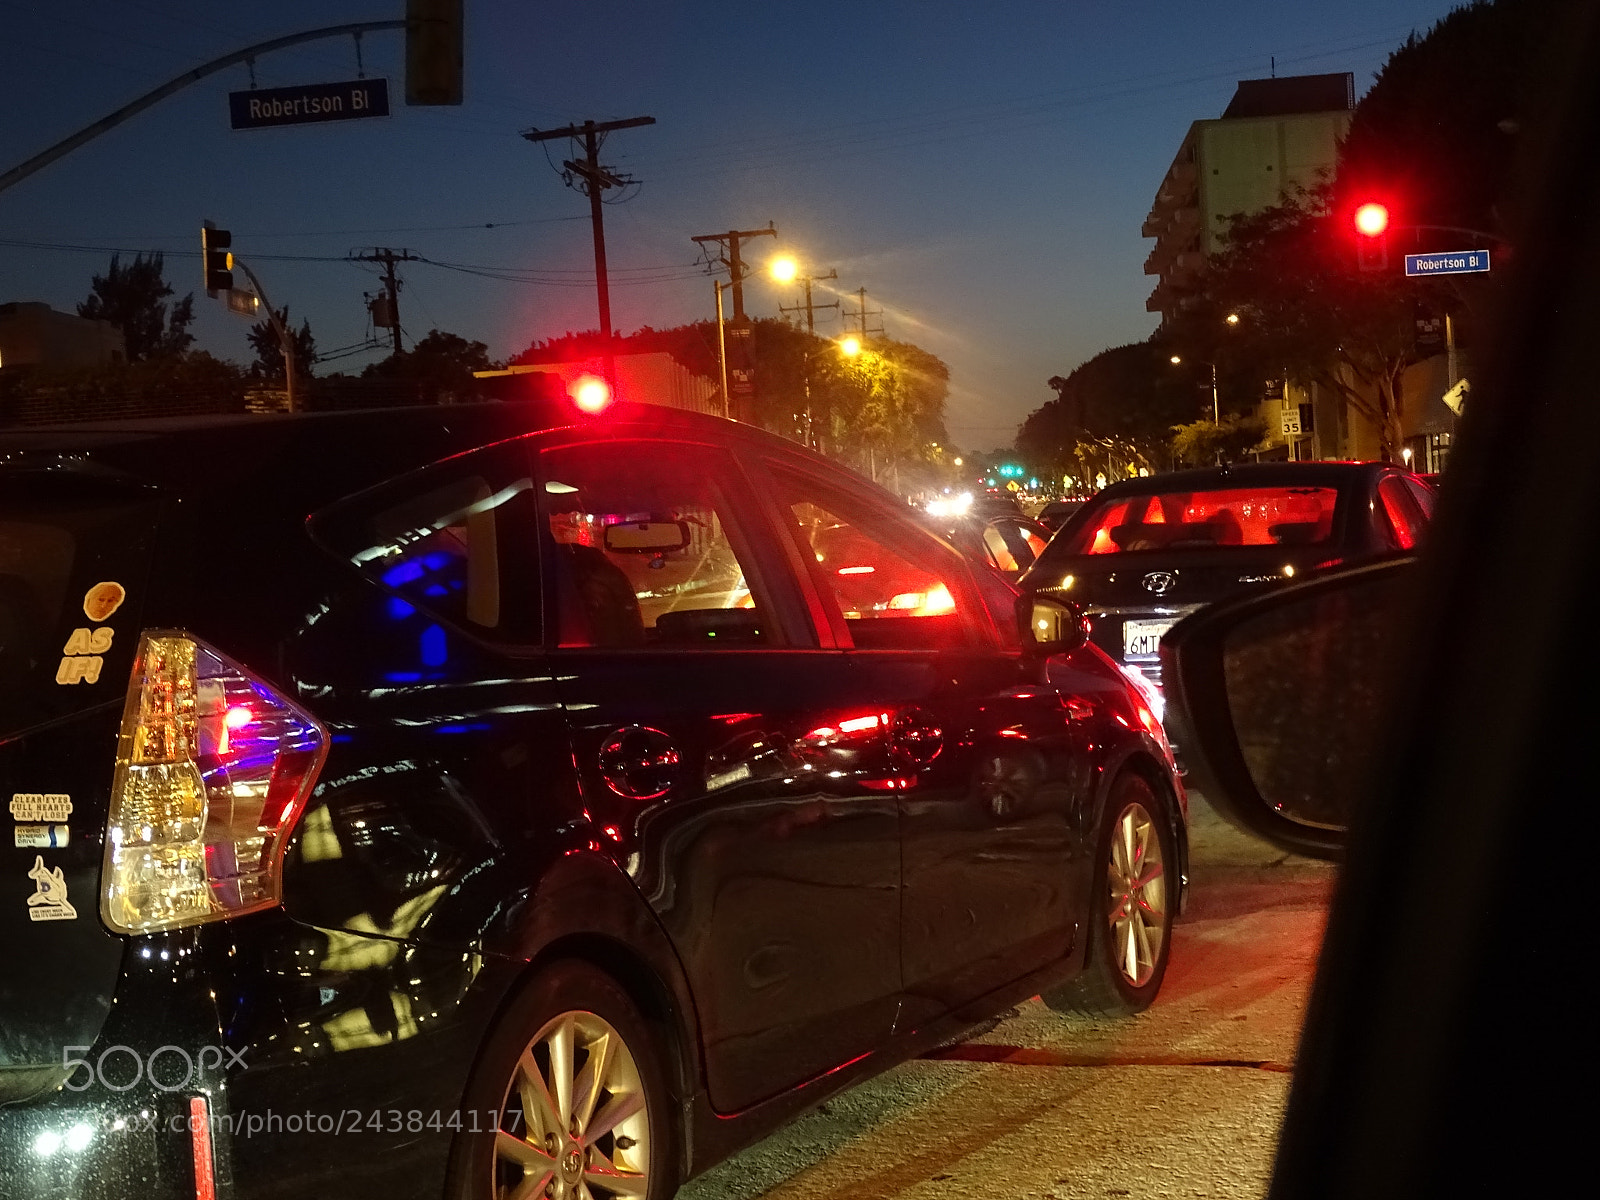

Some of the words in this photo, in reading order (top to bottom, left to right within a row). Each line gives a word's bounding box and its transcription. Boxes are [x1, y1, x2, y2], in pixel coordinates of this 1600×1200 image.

[250, 95, 343, 119] Robertson
[352, 90, 369, 110] Bl
[1416, 258, 1466, 271] Robertson
[1469, 256, 1479, 267] Bl
[1283, 423, 1299, 433] 35
[14, 796, 41, 804] CLEAR
[45, 796, 68, 804] EYES
[11, 803, 32, 811] FULL
[36, 803, 71, 811] HEARTS
[45, 811, 66, 819] LOSE
